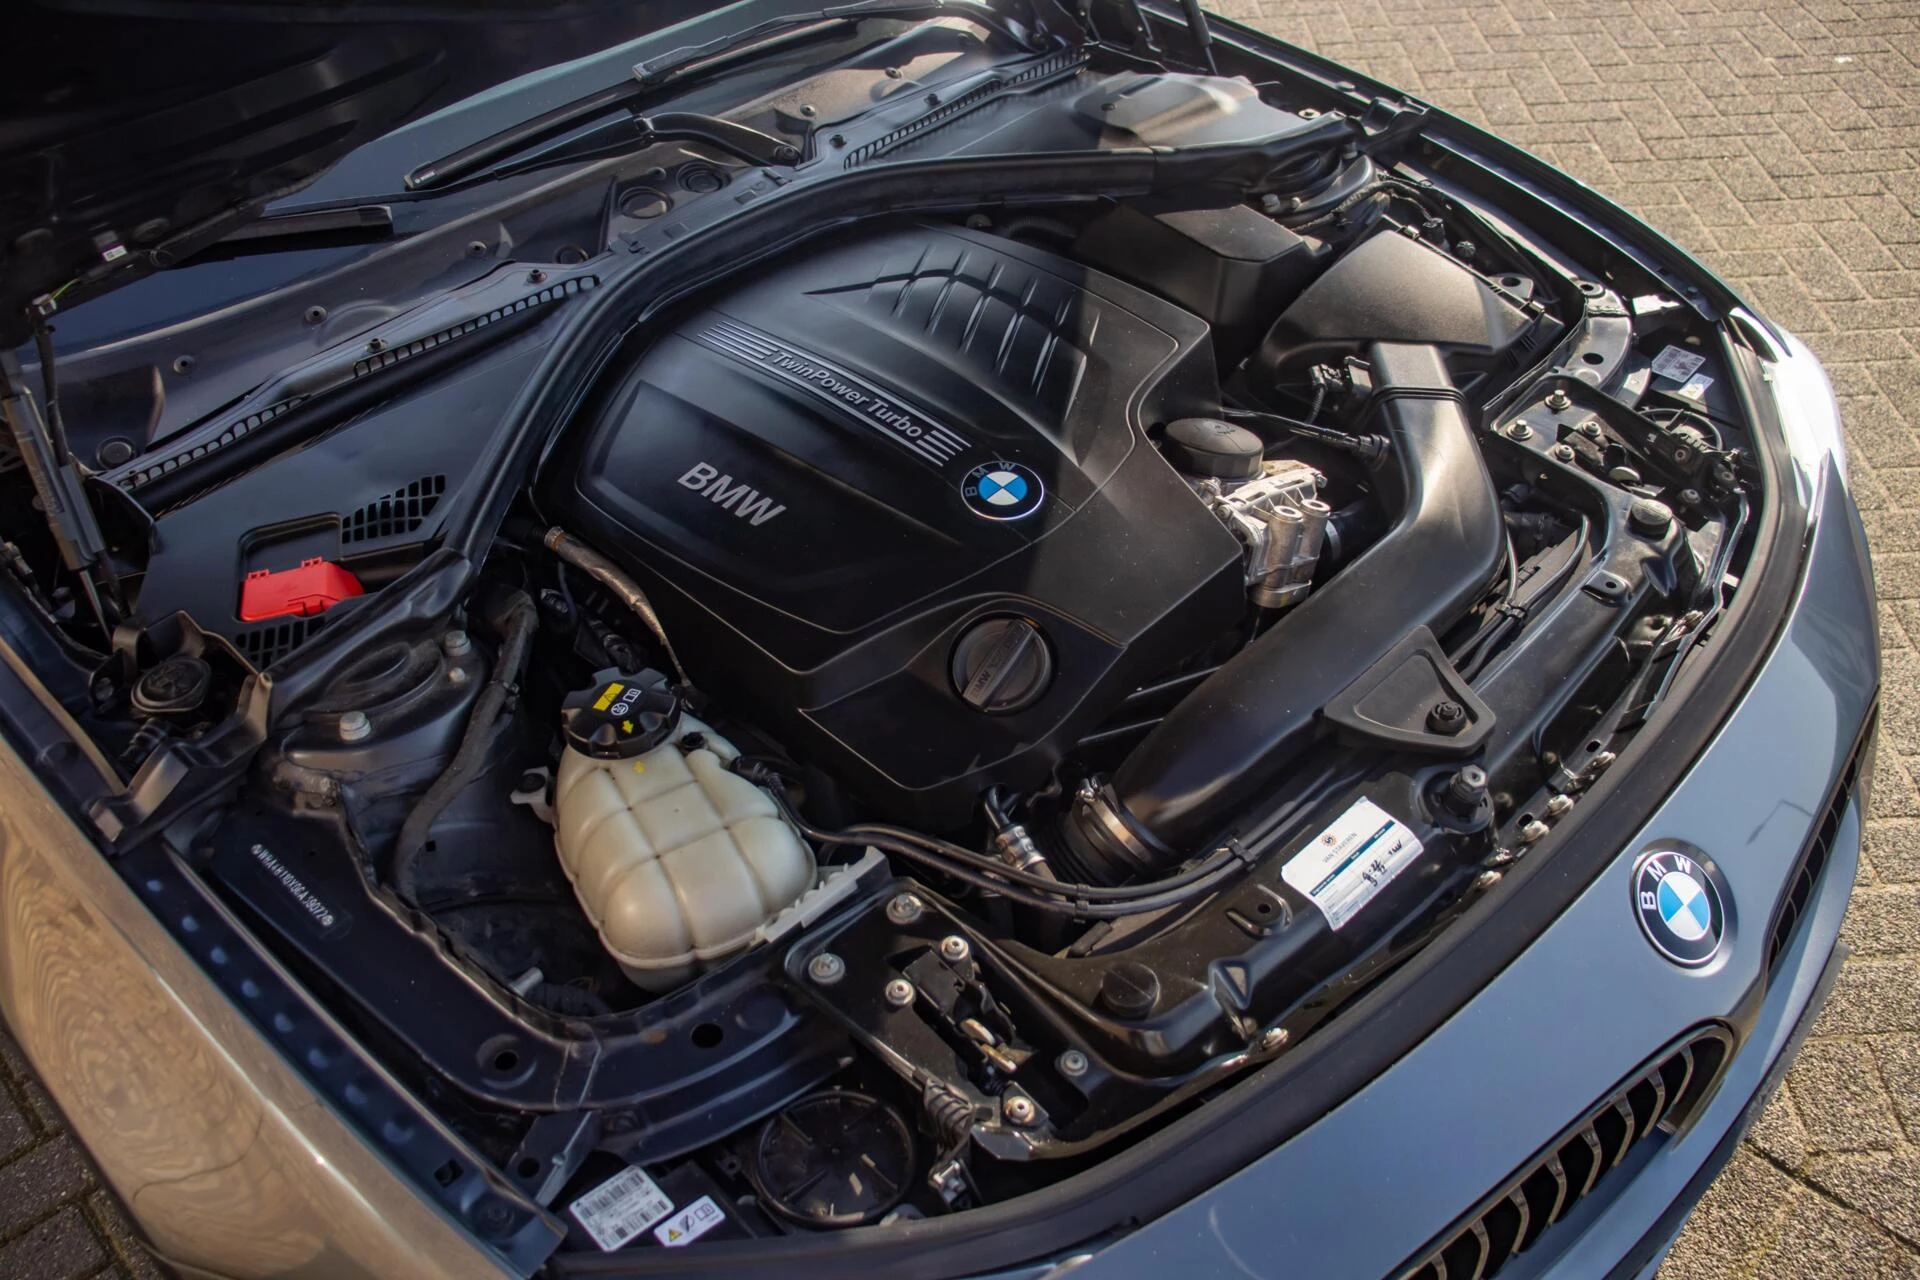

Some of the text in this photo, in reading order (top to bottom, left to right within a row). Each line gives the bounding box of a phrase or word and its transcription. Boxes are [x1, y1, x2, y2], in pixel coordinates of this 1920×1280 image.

[772, 351, 922, 438] TwinPower Turbo
[677, 461, 787, 527] BMW
[965, 460, 1017, 498] BMW
[1640, 855, 1692, 910] BMW
